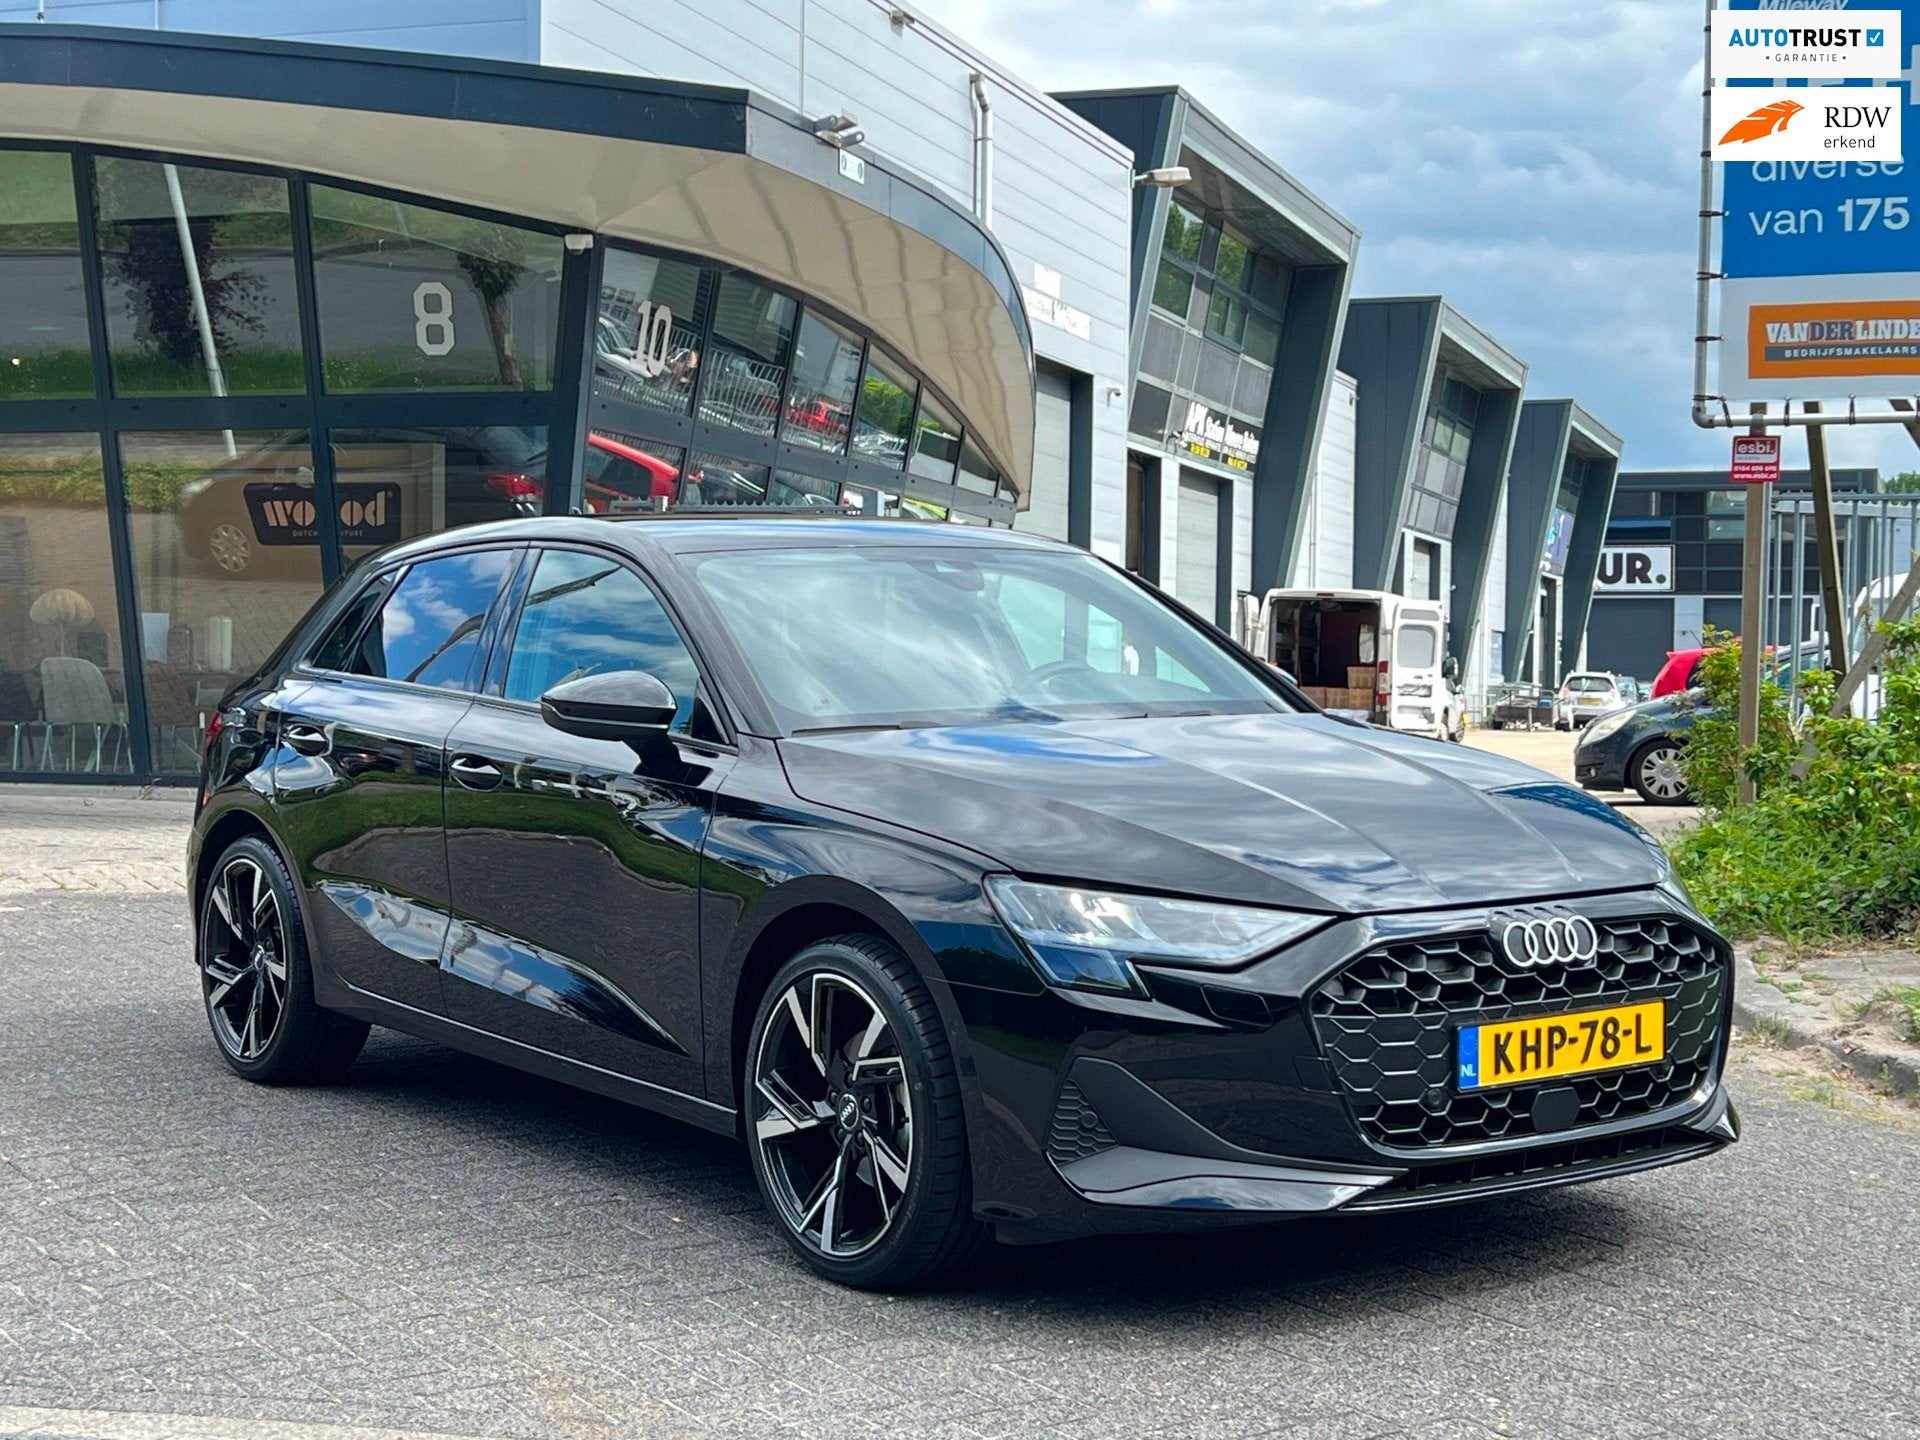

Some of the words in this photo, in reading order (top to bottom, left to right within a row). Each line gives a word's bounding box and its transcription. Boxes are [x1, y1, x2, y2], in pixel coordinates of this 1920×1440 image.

[1749, 207, 1824, 236] van
[1837, 197, 1911, 232] 175
[413, 281, 456, 356] 8
[629, 300, 672, 378] 10
[1784, 345, 1918, 358] BEDRIJFSMAKELAARS
[262, 490, 386, 527] wood
[1493, 1013, 1652, 1076] KHP-78-L
[1461, 1064, 1476, 1077] NL
